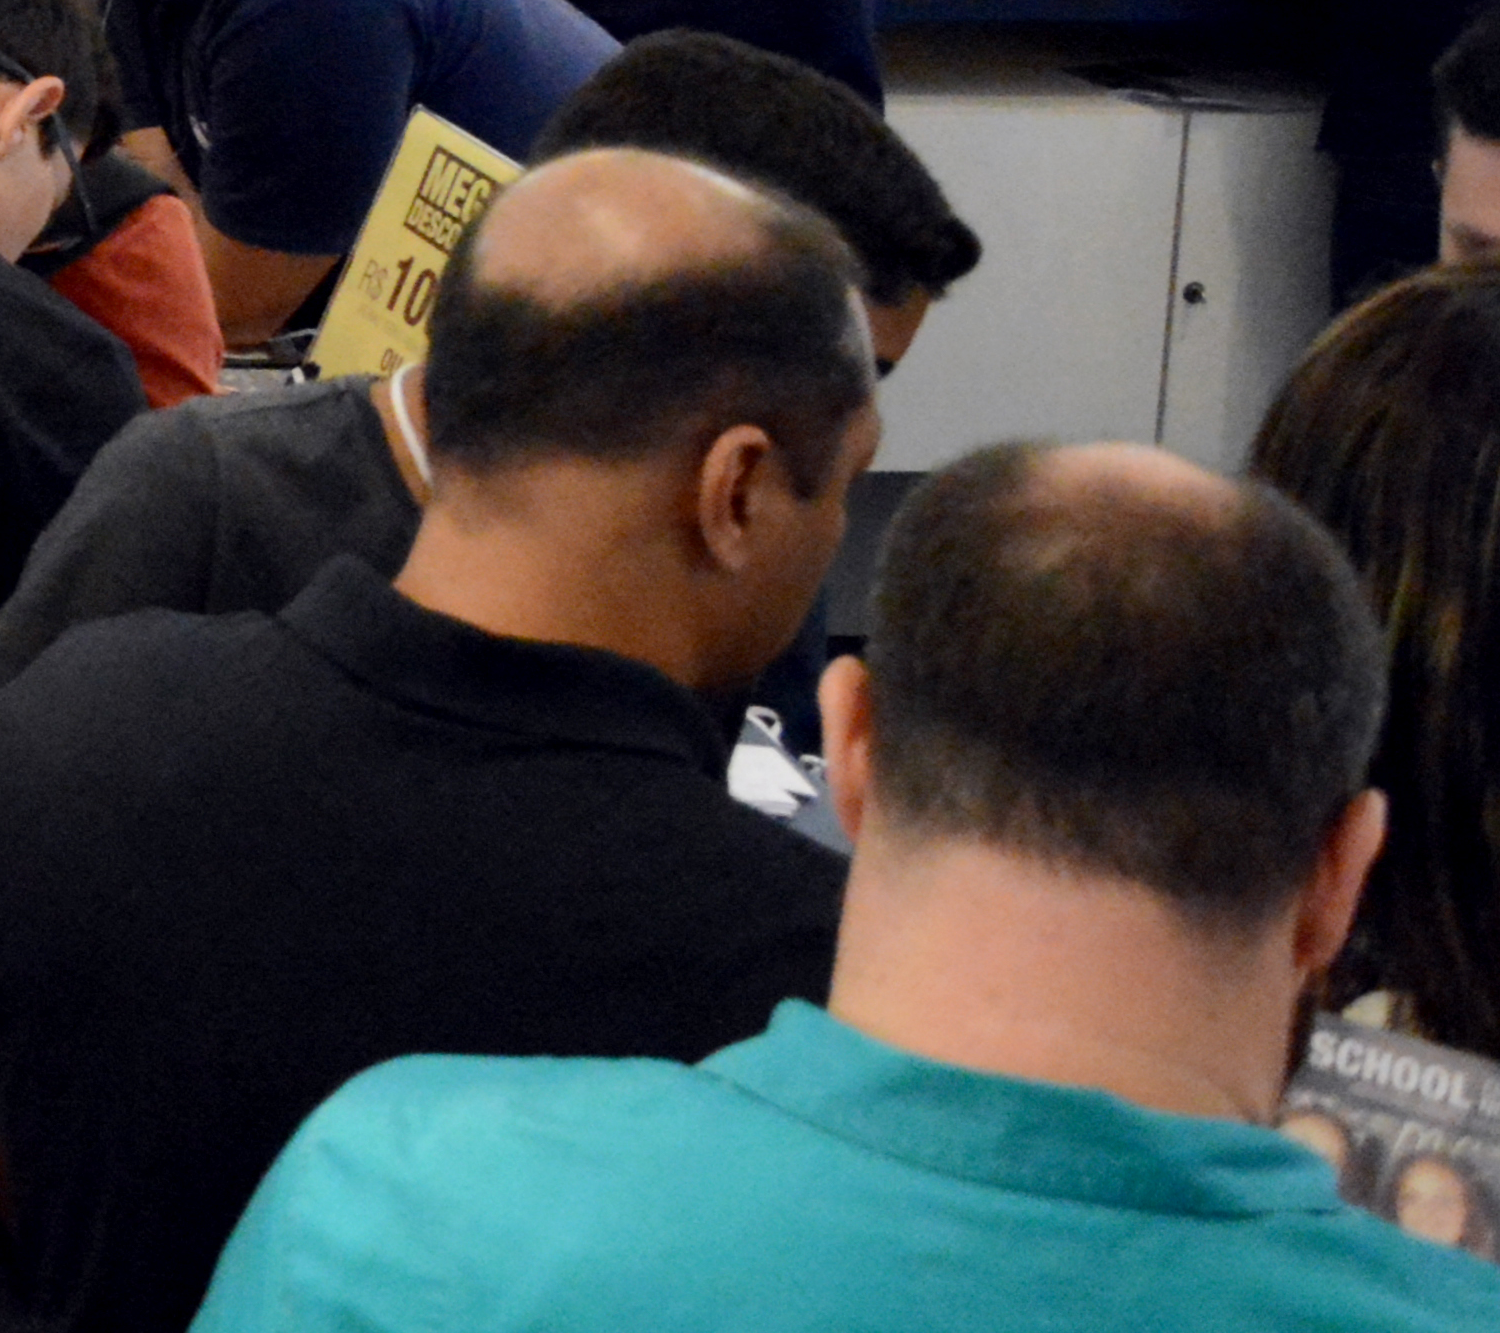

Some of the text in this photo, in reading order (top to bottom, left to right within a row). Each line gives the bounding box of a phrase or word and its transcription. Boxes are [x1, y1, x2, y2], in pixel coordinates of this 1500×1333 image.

[407, 201, 462, 245] DESCO
[420, 151, 490, 224] MEG
[1309, 1031, 1472, 1109] SCHOOL
